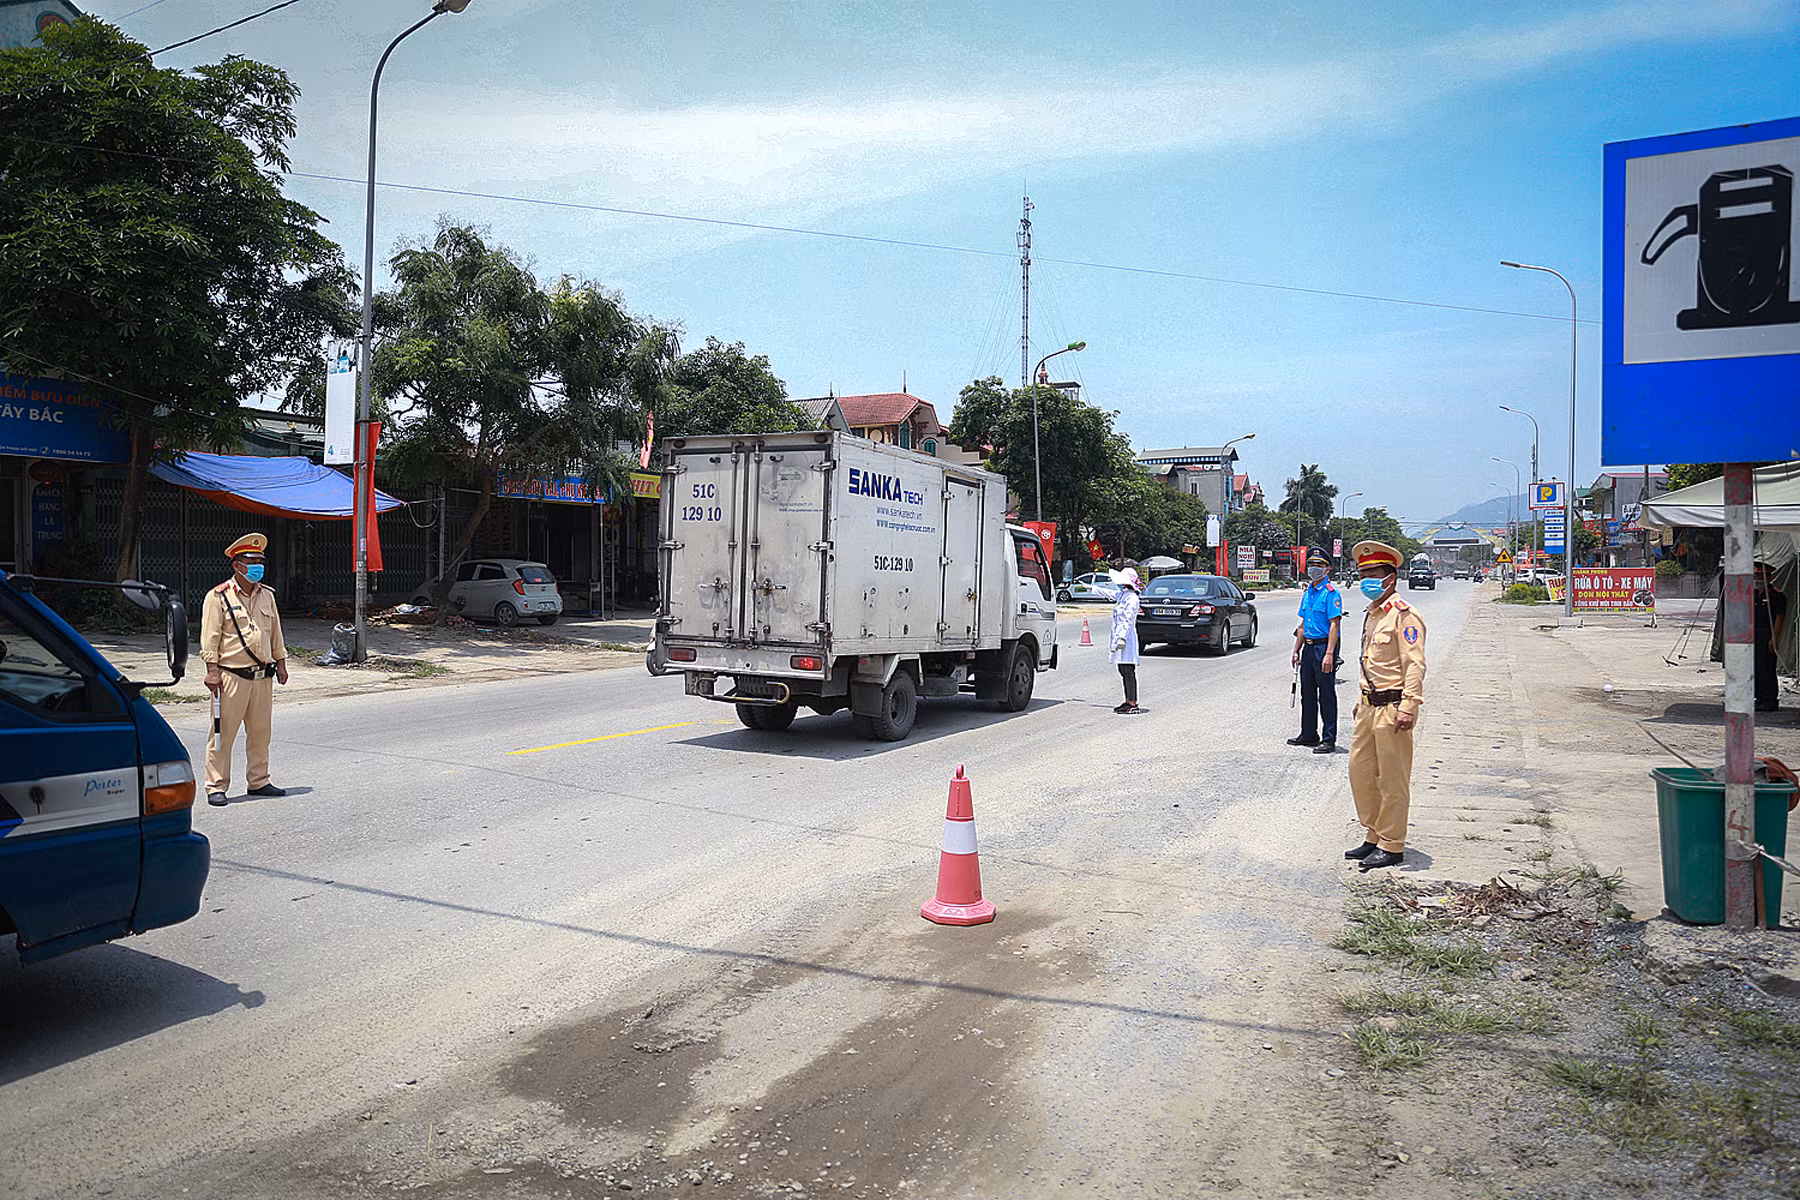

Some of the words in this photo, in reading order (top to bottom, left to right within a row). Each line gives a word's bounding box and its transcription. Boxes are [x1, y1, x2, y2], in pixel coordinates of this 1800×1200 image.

[0, 403, 24, 419] ÂY
[29, 406, 64, 423] BẮC
[692, 483, 715, 499] 51C
[848, 467, 902, 502] SANKA
[903, 490, 923, 506] TECH
[682, 506, 703, 521] 129
[707, 506, 722, 522] 10
[1574, 575, 1592, 590] RỬA
[1594, 576, 1600, 590] Ô
[1602, 576, 1613, 590] TÔ
[1621, 577, 1631, 590] XE
[1634, 575, 1653, 590] MÁY
[1578, 591, 1594, 599] DỌN
[1596, 590, 1610, 599] NỘI
[84, 779, 121, 797] Porter
